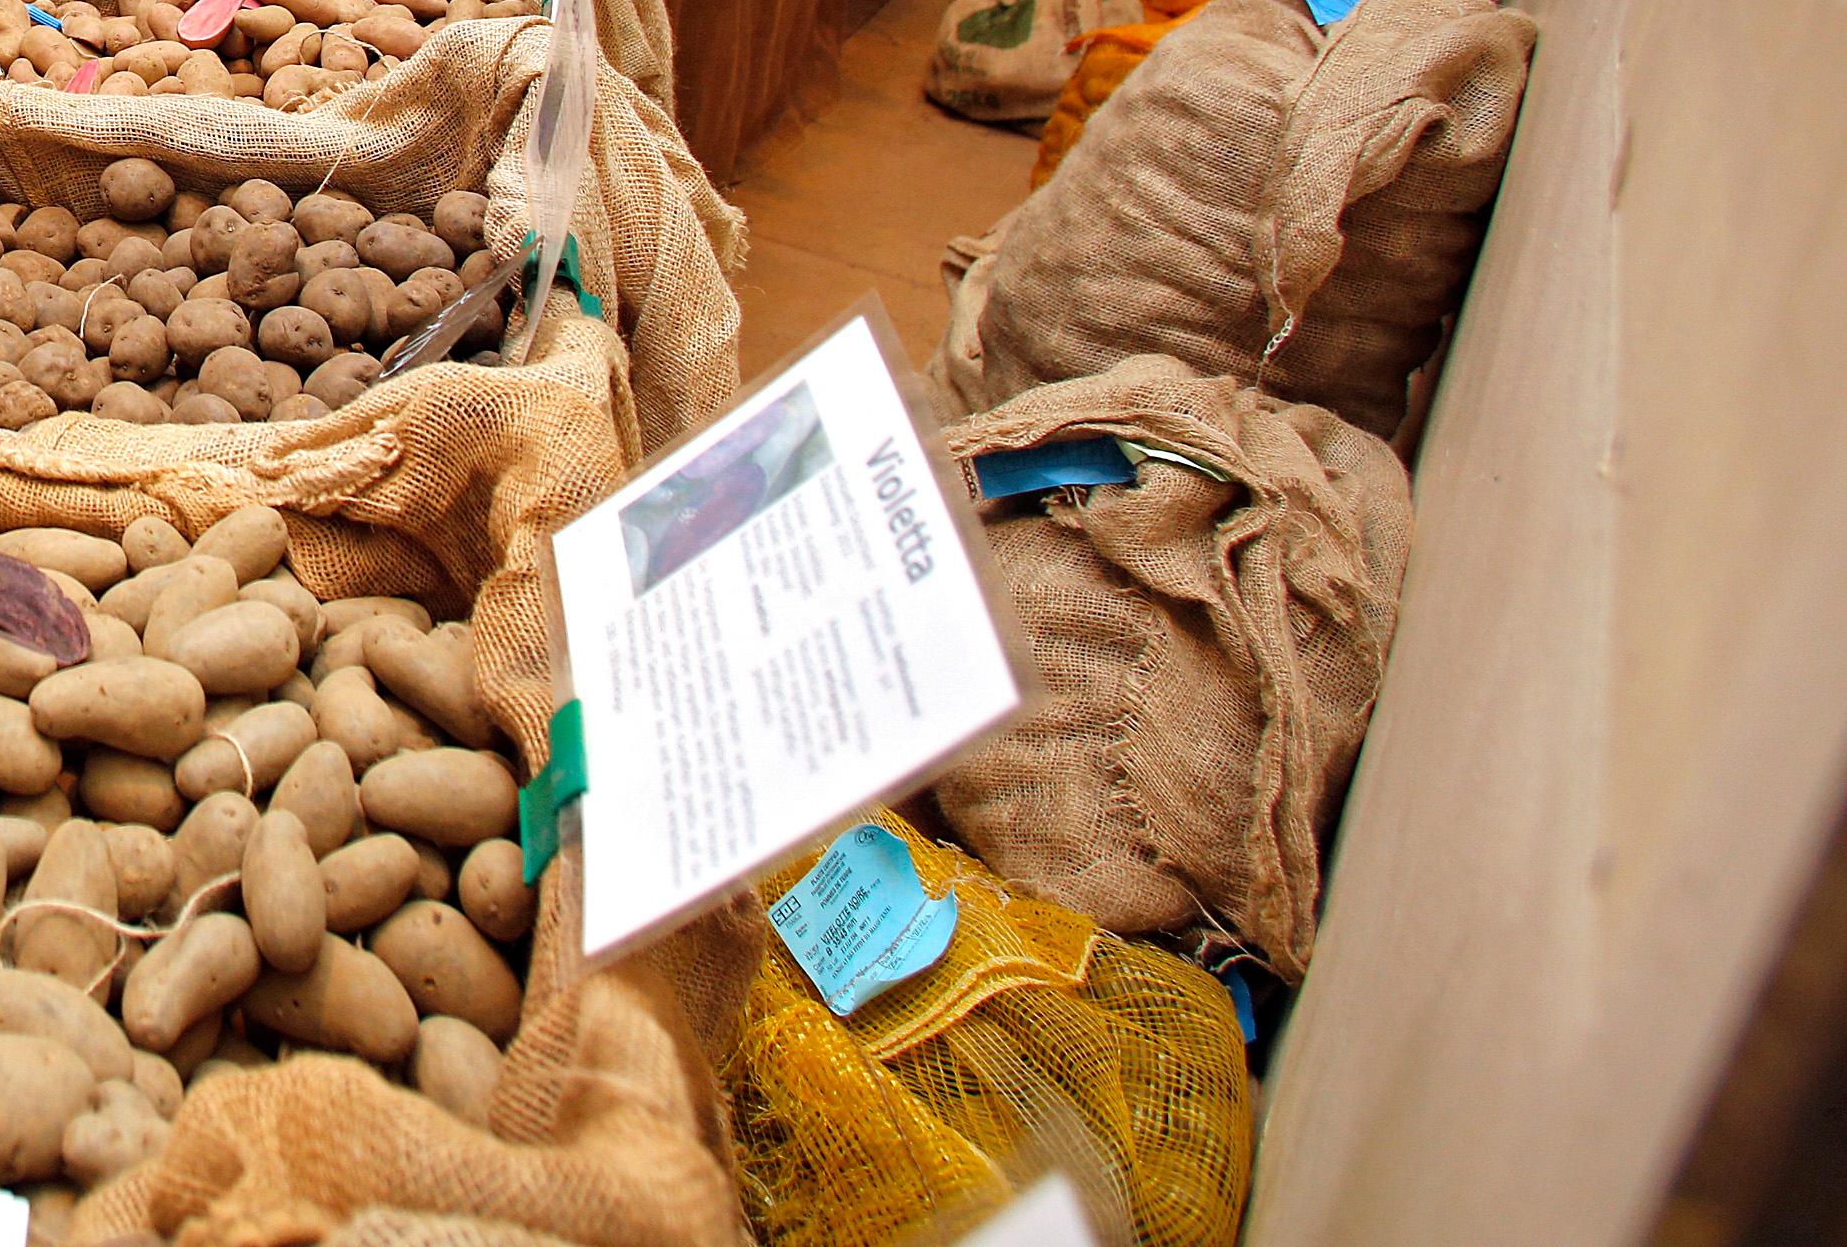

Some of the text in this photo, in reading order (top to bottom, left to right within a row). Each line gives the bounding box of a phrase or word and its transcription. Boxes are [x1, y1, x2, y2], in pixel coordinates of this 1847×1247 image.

[866, 436, 935, 585] Violetta
[820, 906, 850, 944] VITELOTTE
[846, 885, 867, 909] NOIRE
[845, 916, 857, 931] mm
